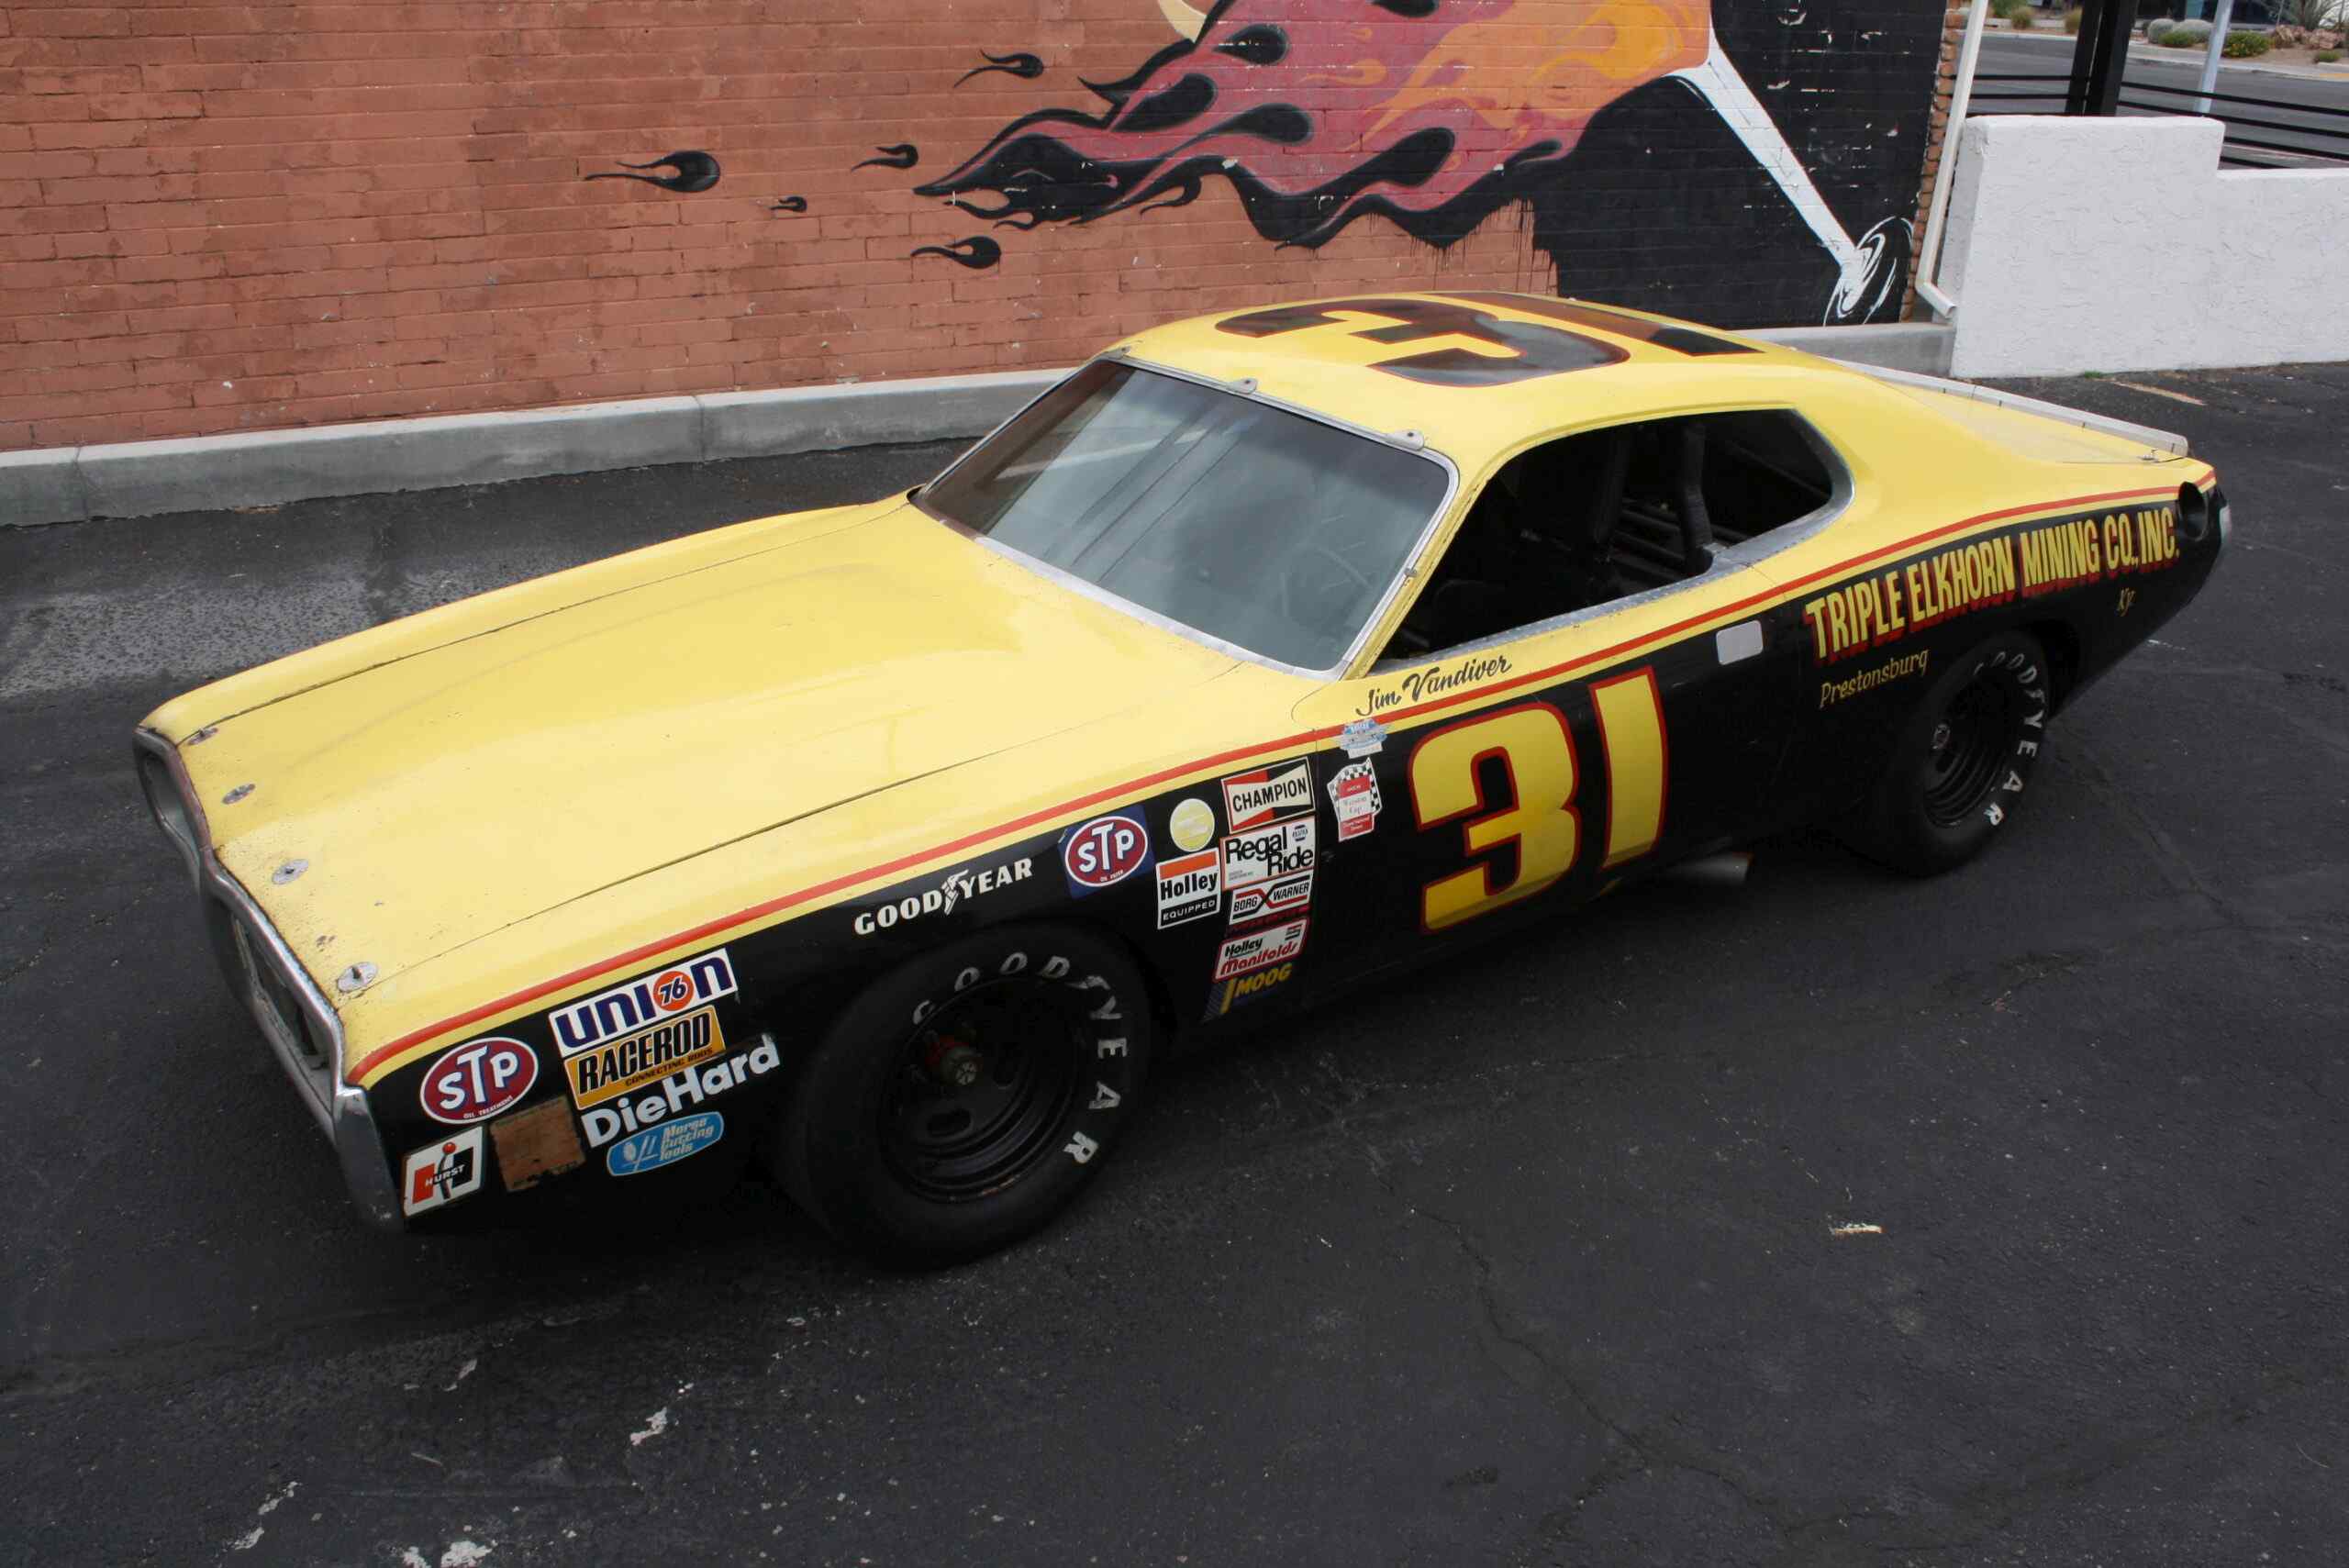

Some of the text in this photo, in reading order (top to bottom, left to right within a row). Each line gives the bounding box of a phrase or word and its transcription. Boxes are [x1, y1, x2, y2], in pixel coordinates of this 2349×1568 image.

[1804, 571, 1906, 662] TRIPLE
[1906, 536, 2016, 625] ELKHORN
[2020, 519, 2100, 590] MINING
[2137, 506, 2180, 565] INC.
[1355, 655, 1512, 717] Jim Vandiver
[1820, 648, 1929, 708] Prestonsburg
[1232, 778, 1308, 812] CHAMPION
[1408, 664, 1670, 934] 31
[1077, 822, 1134, 873] STP
[1225, 826, 1287, 863] Regal
[1267, 846, 1314, 876] Ride
[854, 858, 1033, 936] GOODYEAR
[1160, 873, 1219, 901] Holley
[1233, 882, 1310, 912] BORG WARNER
[1163, 900, 1216, 921] EQUIPPED
[1225, 938, 1264, 957] Holley
[660, 975, 687, 1006] 76
[1233, 962, 1293, 997] MOOG
[577, 1012, 713, 1095] RACEROD
[438, 1046, 518, 1109] STP
[581, 1033, 780, 1148] DieHard
[425, 1164, 466, 1186] HURST
